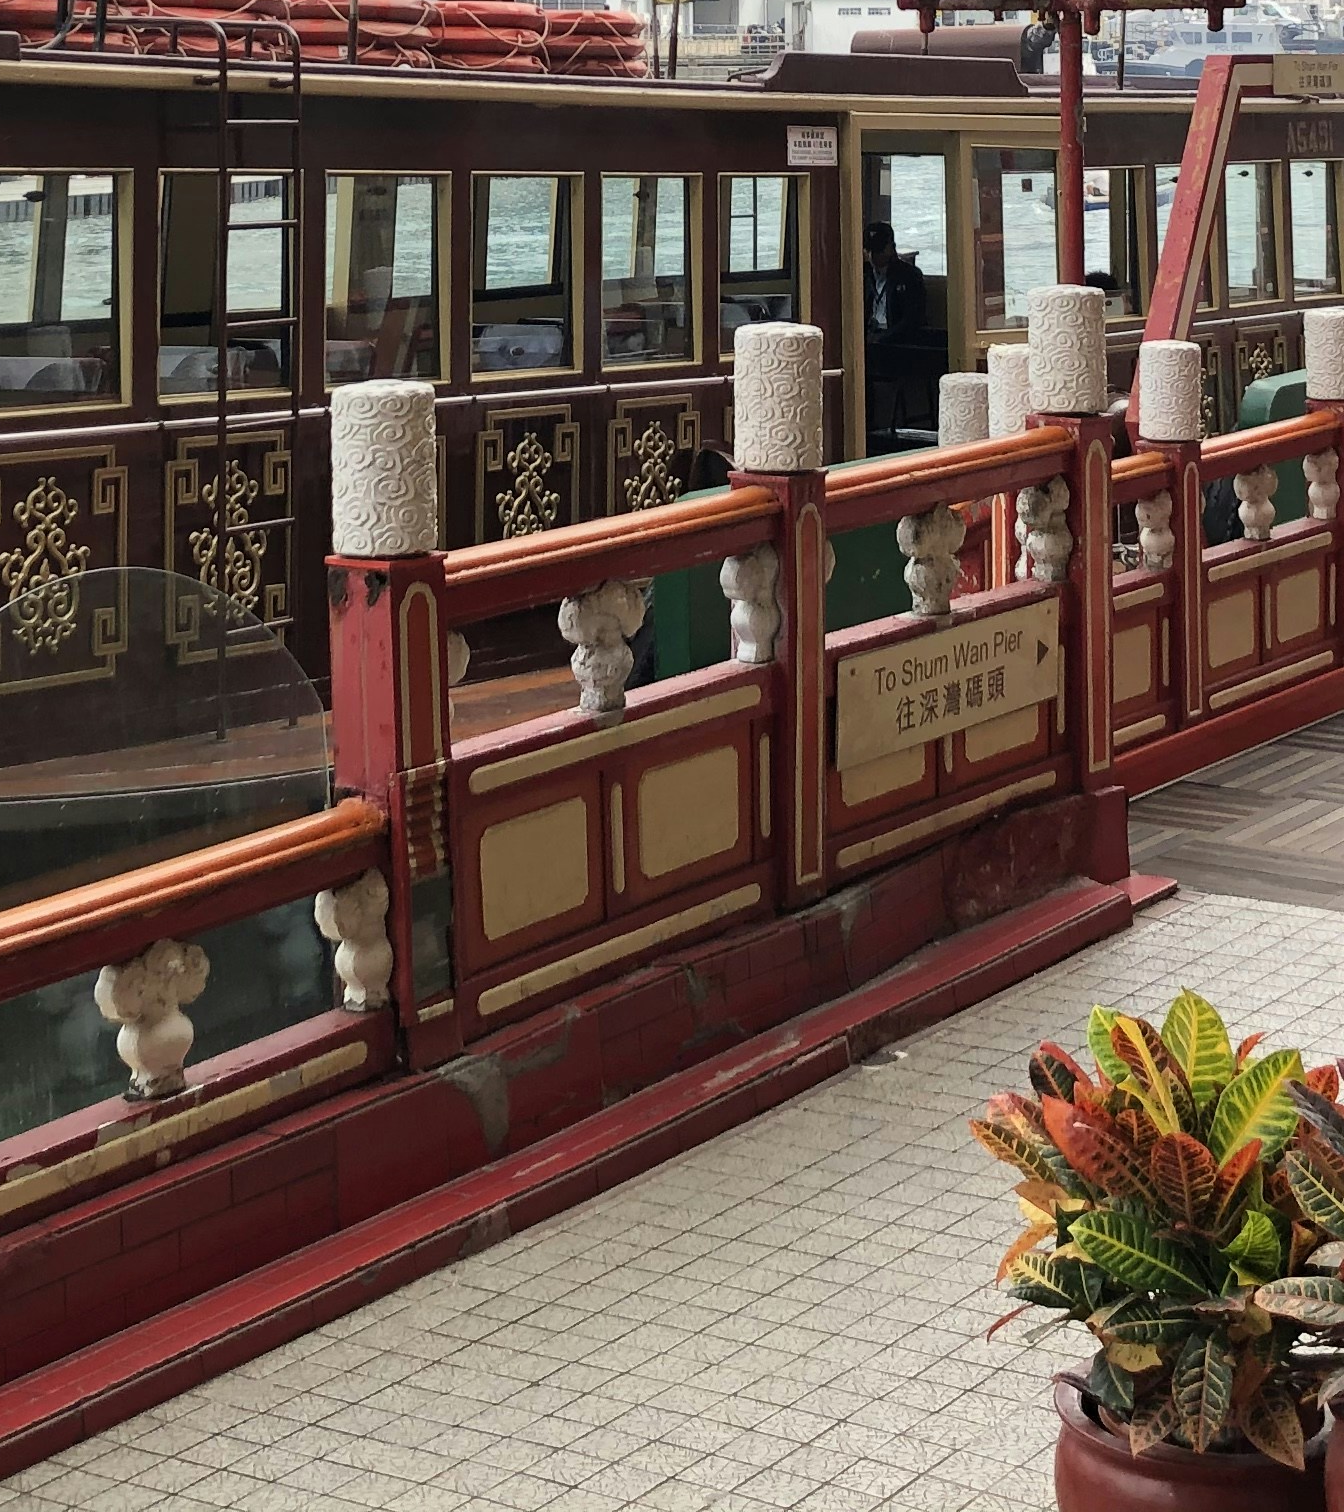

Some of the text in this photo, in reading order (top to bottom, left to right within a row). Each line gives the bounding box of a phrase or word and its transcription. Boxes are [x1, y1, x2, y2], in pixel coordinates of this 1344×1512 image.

[1214, 43, 1244, 52] POLICE
[1256, 33, 1264, 42] 7
[874, 629, 1024, 695] To Shum Wan Pier
[896, 665, 1006, 735] 往深灣碼頭
